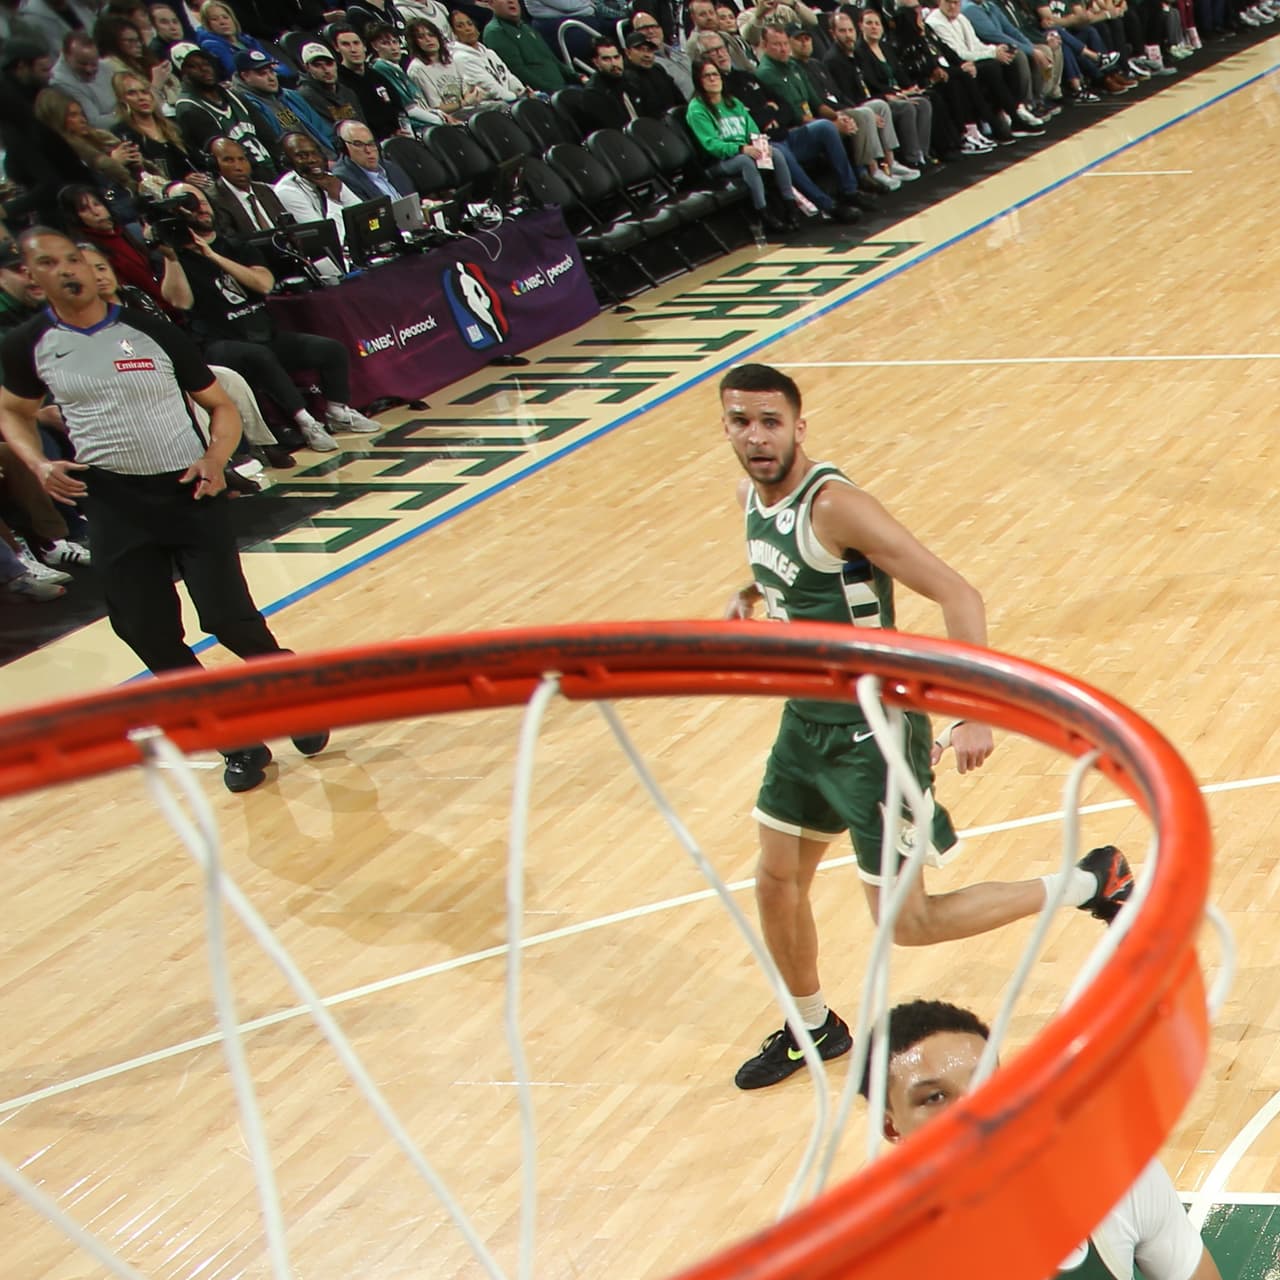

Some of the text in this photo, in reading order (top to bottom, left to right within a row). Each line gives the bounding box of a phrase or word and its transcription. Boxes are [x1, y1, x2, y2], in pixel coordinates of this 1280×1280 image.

[525, 254, 574, 292] NBC peacock
[624, 242, 927, 323] FEAR
[372, 315, 437, 352] NBC peacock
[116, 360, 154, 371] Emirates
[448, 330, 758, 405] THE
